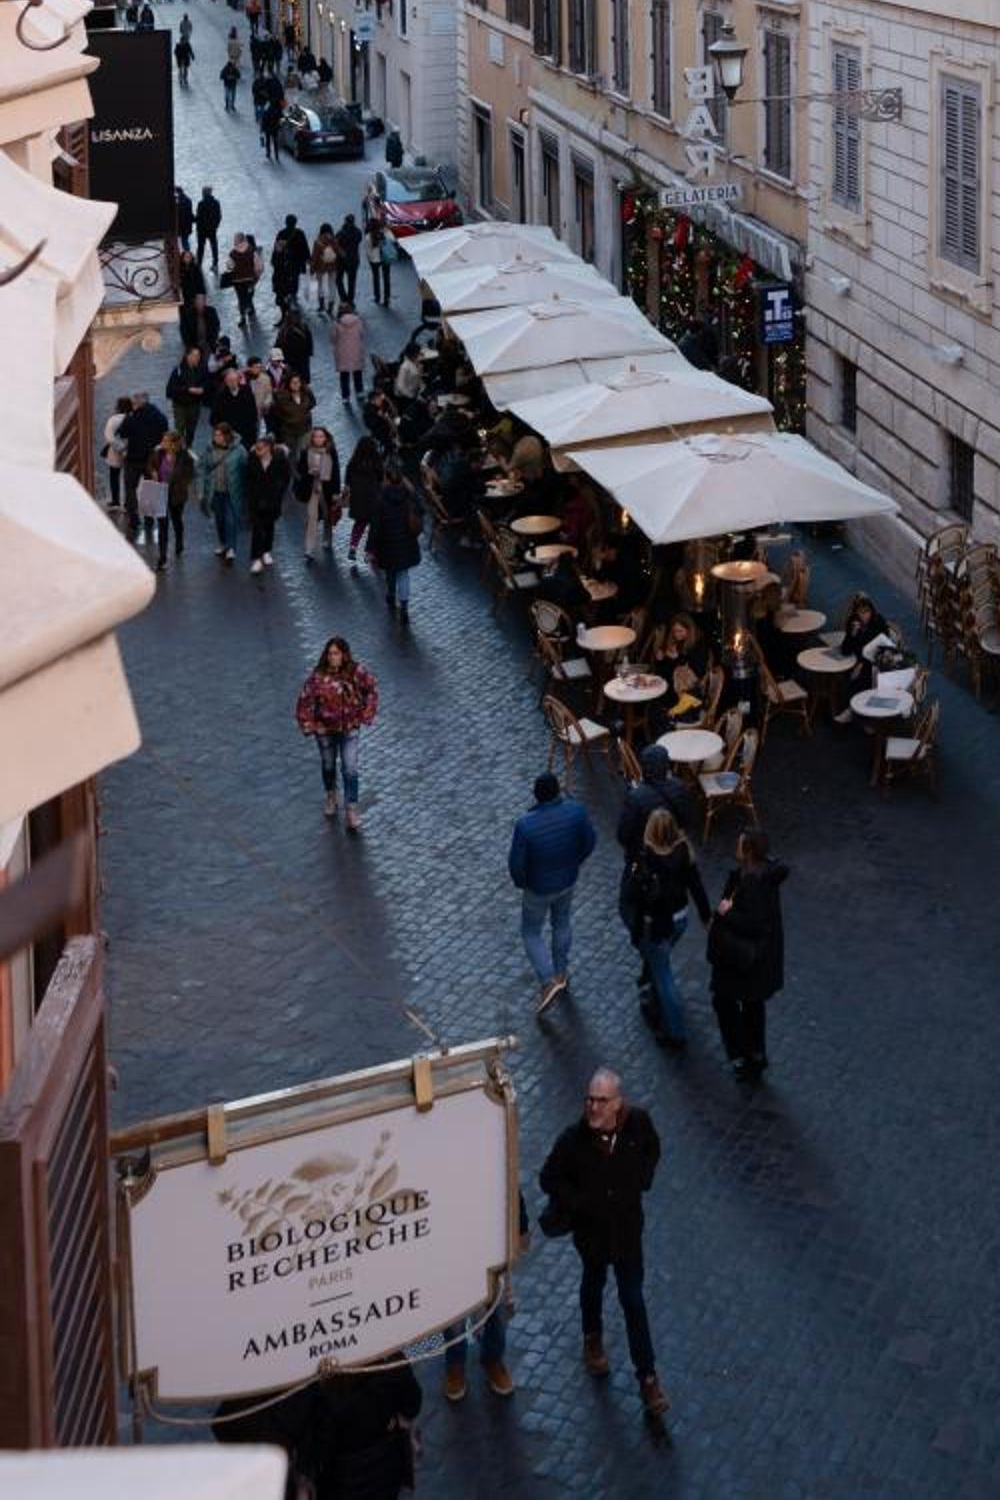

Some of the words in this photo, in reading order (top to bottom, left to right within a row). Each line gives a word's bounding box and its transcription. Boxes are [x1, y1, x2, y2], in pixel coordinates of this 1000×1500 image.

[91, 127, 153, 143] LISANZA
[665, 185, 739, 205] GELATERIA
[226, 1188, 431, 1263] BIOLOGIQUE
[227, 1216, 432, 1291] RECHERCHE
[308, 1267, 353, 1290] PARIS
[242, 1288, 422, 1360] AMBASSADE
[308, 1334, 359, 1359] ROMA
